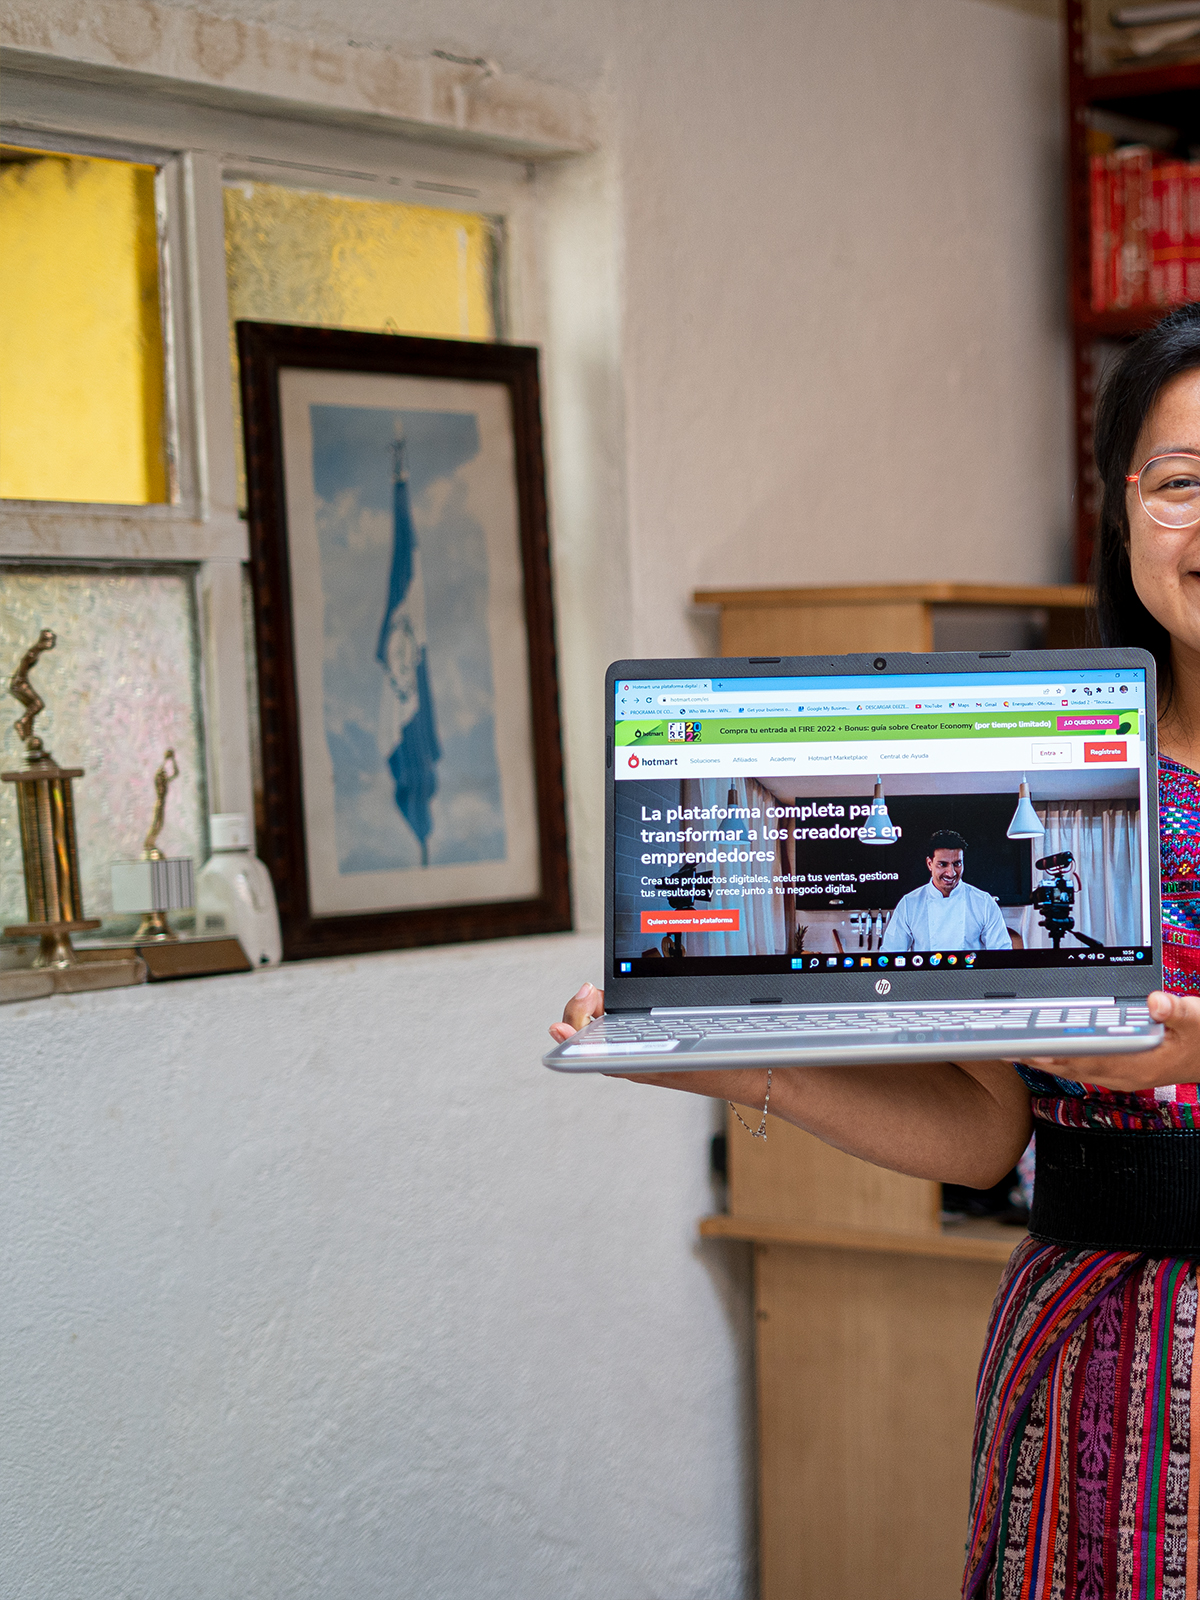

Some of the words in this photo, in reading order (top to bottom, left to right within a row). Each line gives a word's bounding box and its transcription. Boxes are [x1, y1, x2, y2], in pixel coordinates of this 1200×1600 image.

[720, 727, 748, 736] Compra
[871, 723, 887, 733] guía
[889, 723, 909, 731] sobre
[910, 722, 938, 730] Creator
[940, 722, 973, 731] Economy
[974, 721, 990, 730] (por
[991, 721, 1017, 730] tiempo
[1018, 720, 1051, 729] limitado)
[642, 758, 678, 766] hotmart
[833, 754, 868, 762] Marketplace
[641, 806, 661, 821] La
[666, 805, 761, 824] plataforma
[766, 802, 845, 821] completa
[850, 804, 888, 820] para
[640, 827, 743, 843] transformar
[748, 830, 758, 840] a
[763, 826, 788, 840] los
[793, 824, 876, 840] creadores
[881, 826, 902, 838] en
[640, 848, 775, 867] emprendedores
[641, 876, 663, 885] Crea
[664, 876, 679, 885] tus
[681, 875, 727, 886] productos
[729, 875, 771, 885] digitales,
[773, 873, 806, 882] acelera
[807, 873, 823, 882] tus
[824, 873, 857, 882] ventas,
[859, 871, 899, 882] gestiona
[640, 889, 656, 897] tus
[657, 888, 706, 897] resultados
[707, 889, 714, 898] y
[741, 886, 766, 897] junto
[775, 886, 785, 894] tu
[787, 885, 823, 896] negocio
[825, 884, 857, 895] digital.
[876, 979, 891, 995] hp
